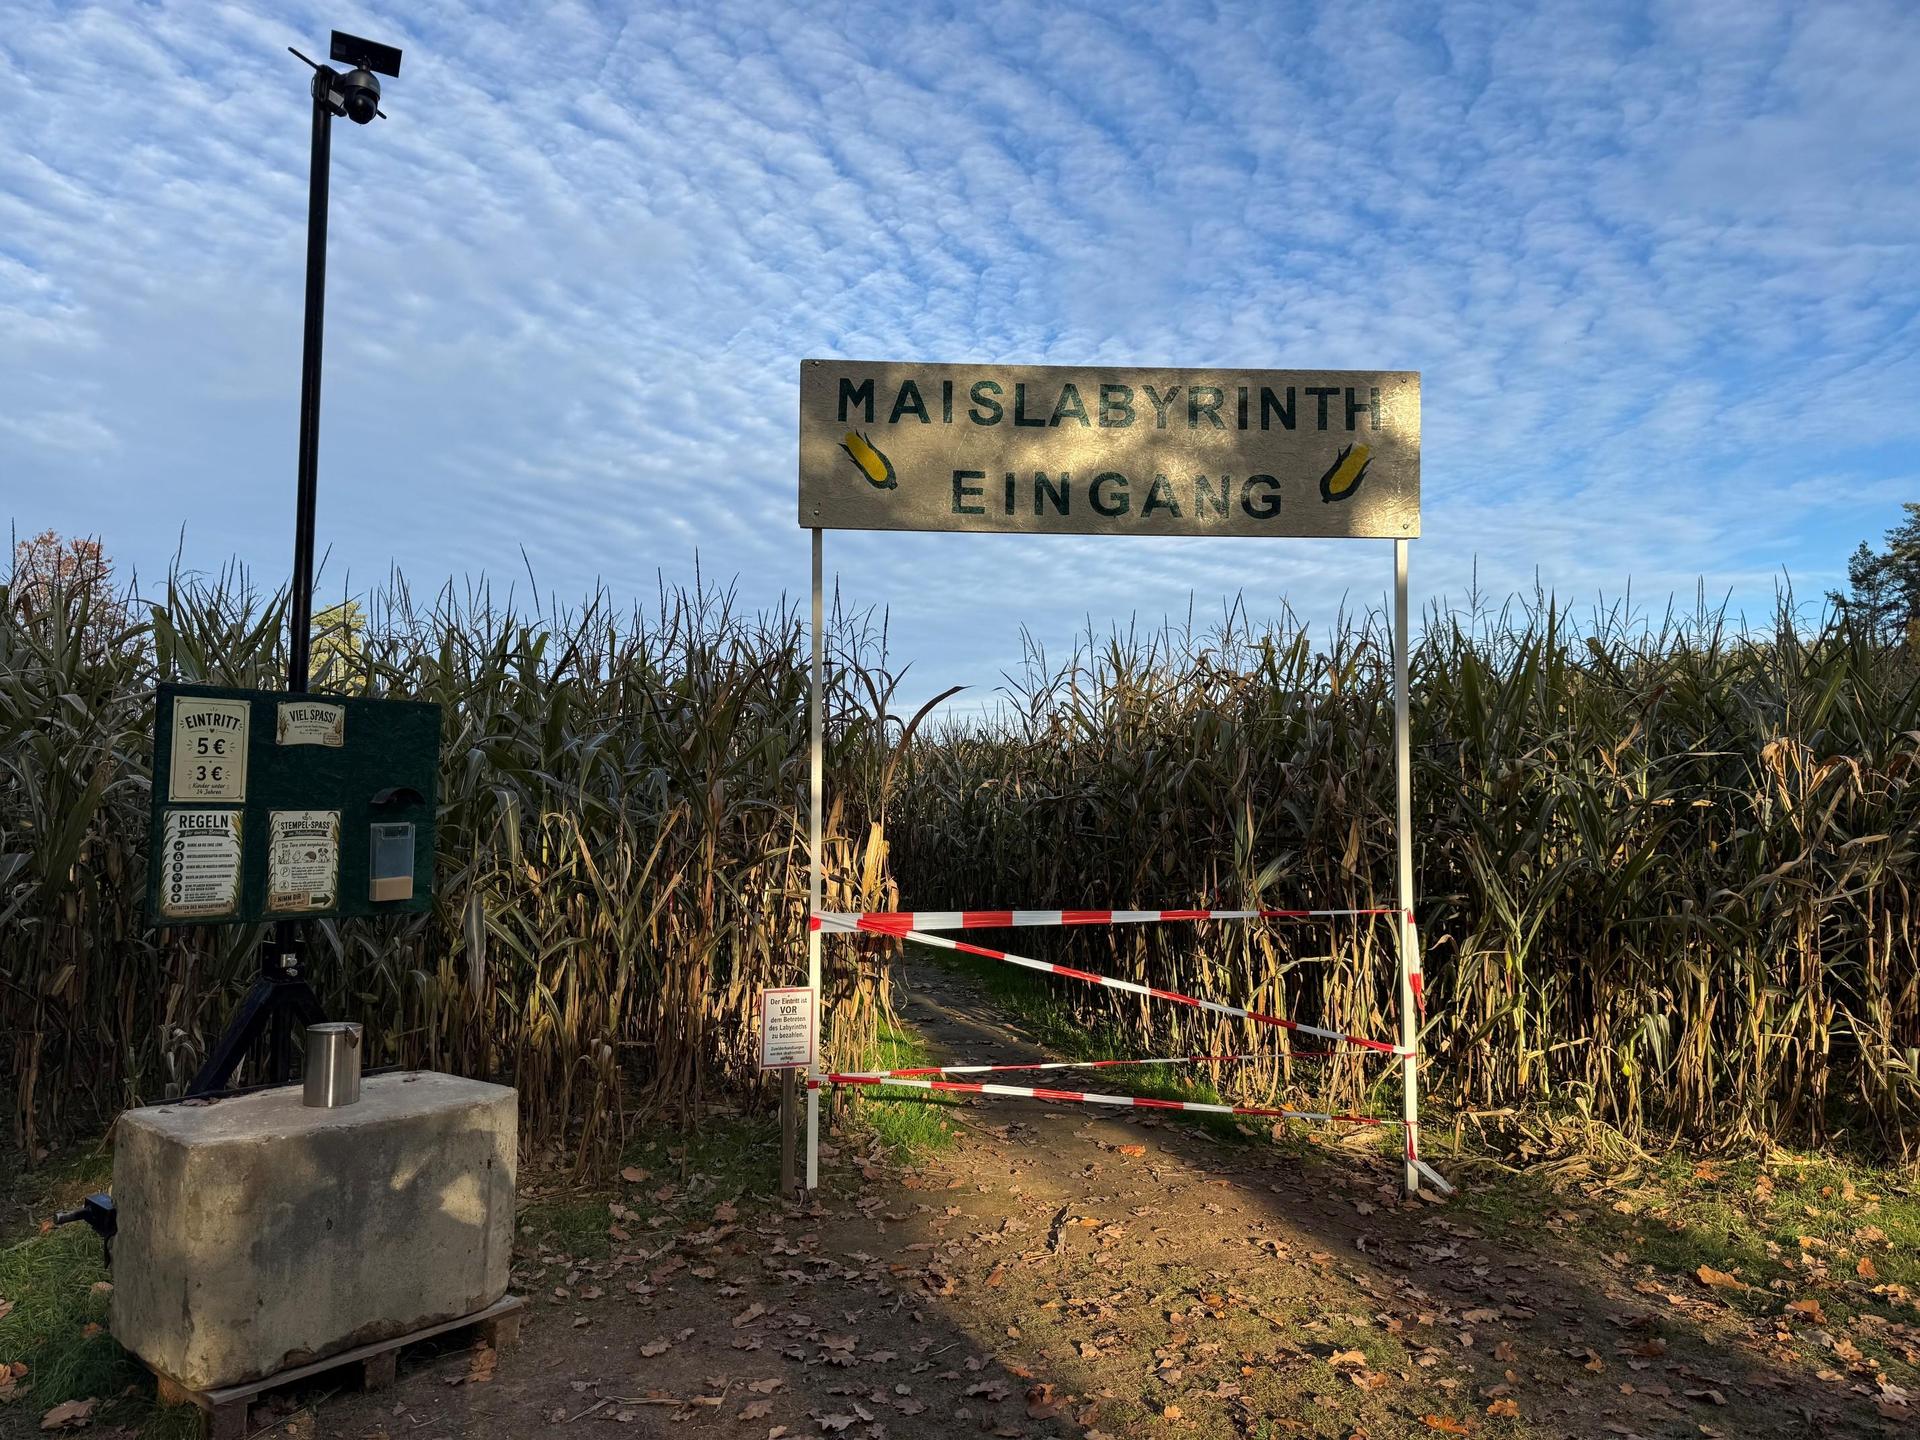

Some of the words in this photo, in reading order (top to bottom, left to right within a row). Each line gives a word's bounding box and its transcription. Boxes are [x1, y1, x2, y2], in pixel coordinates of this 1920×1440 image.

[837, 378, 1381, 431] MAISLABYRINTH
[952, 470, 1282, 520] EINGANG
[185, 712, 241, 730] EINTRITT
[289, 709, 308, 722] VIEL
[310, 709, 336, 724] SPASS!
[197, 737, 208, 755] 5
[213, 738, 225, 755] €
[196, 765, 206, 781] 3
[211, 766, 222, 781] €
[179, 814, 228, 828] REGELN
[281, 820, 330, 830] STEMPEL-SPASS
[782, 997, 800, 1005] Eintritt
[780, 1005, 797, 1014] VOR
[780, 1024, 807, 1032] Labyrinths
